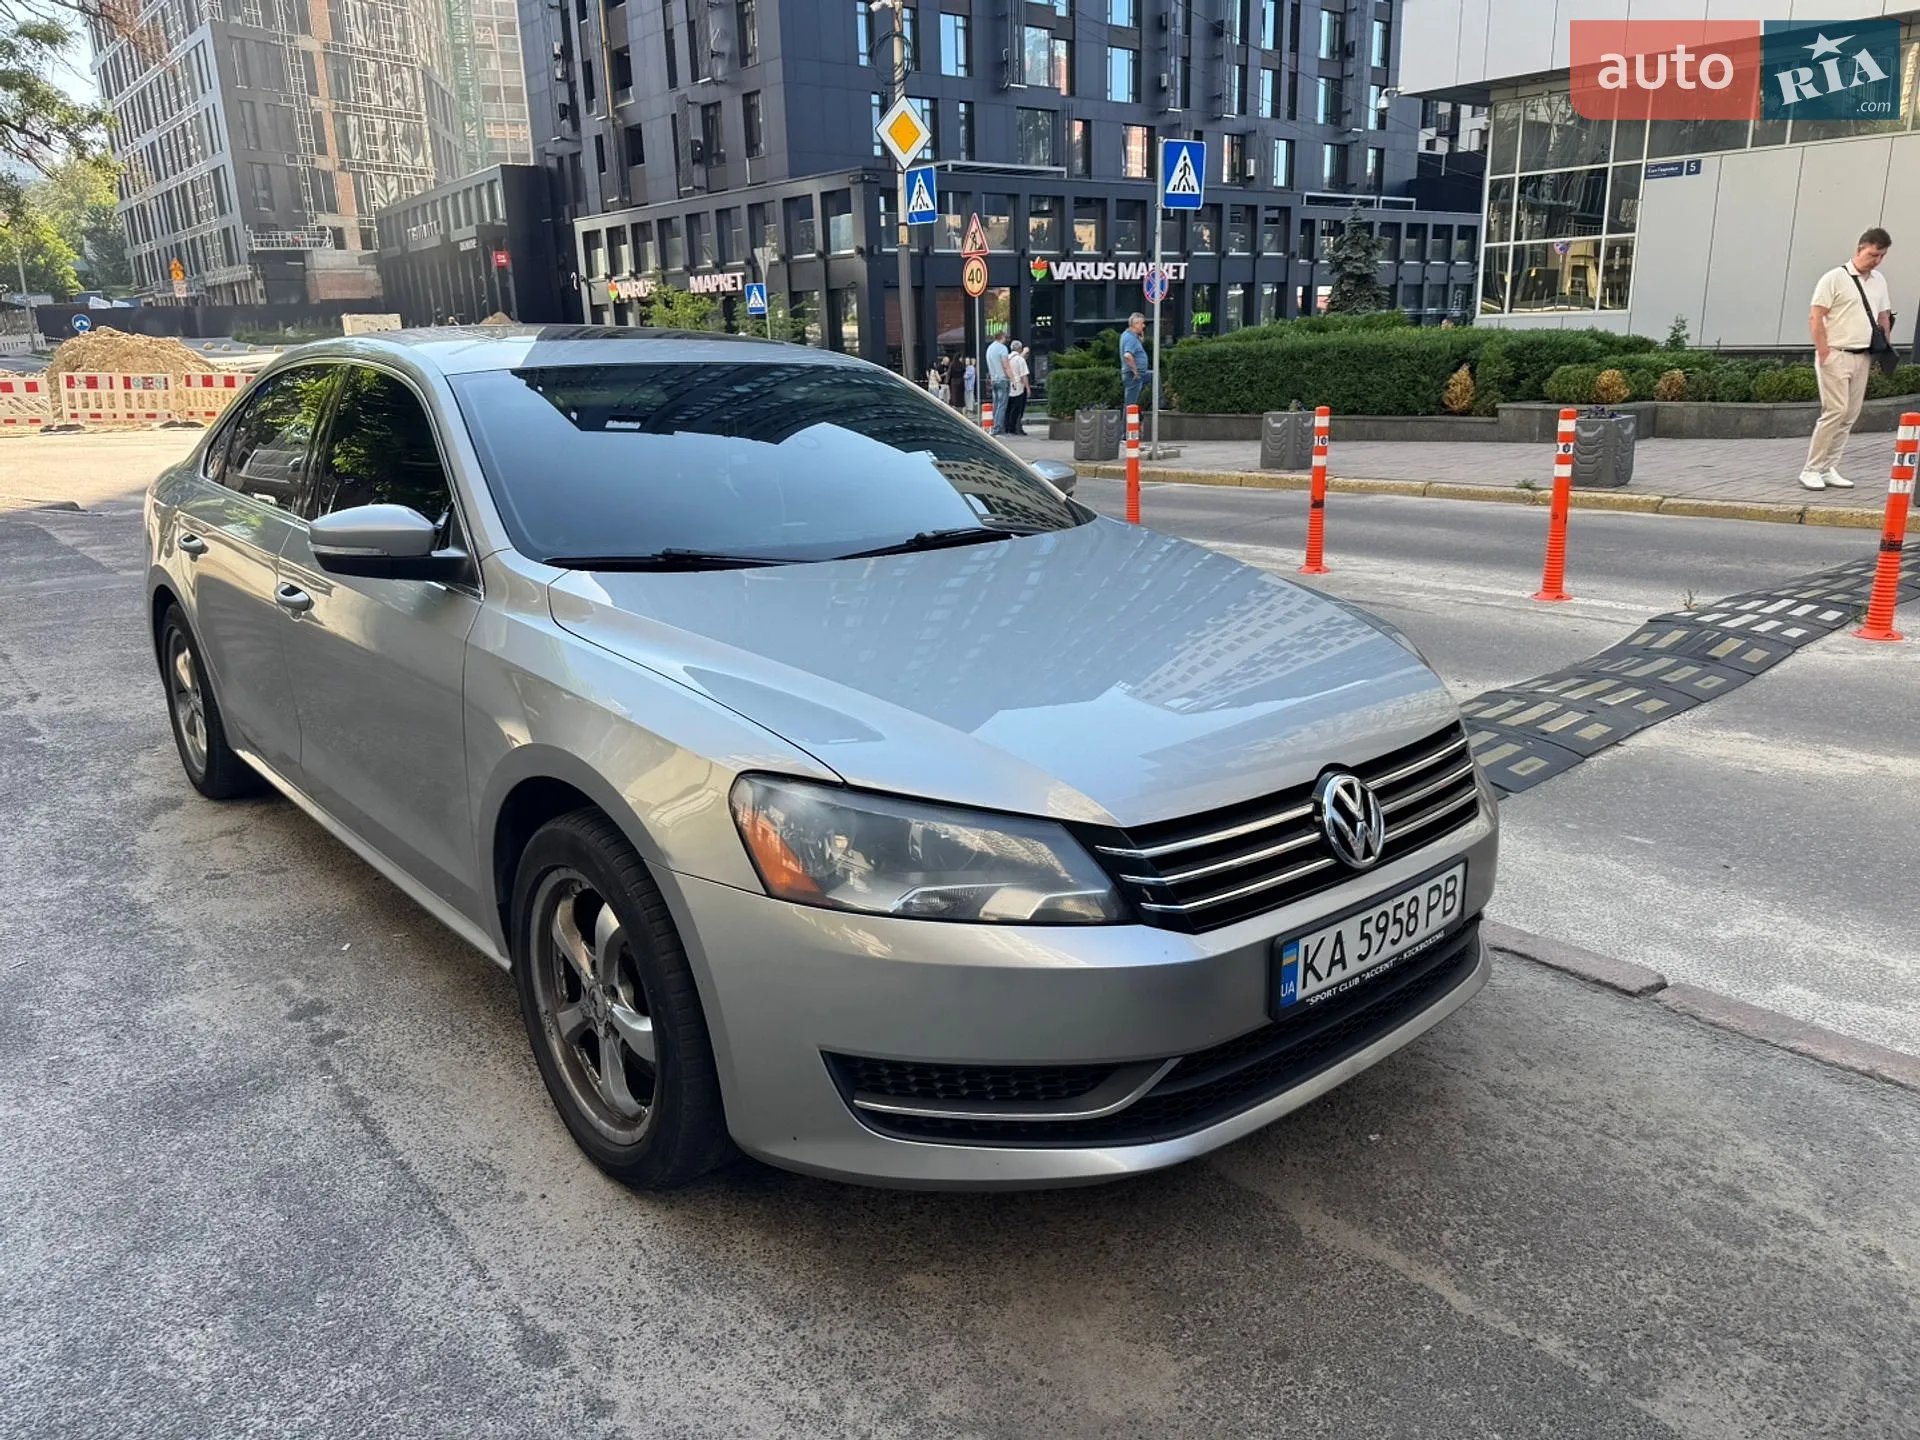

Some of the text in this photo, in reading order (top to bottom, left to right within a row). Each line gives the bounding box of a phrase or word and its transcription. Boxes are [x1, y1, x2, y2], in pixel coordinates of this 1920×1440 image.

[1689, 161, 1697, 172] 5
[967, 267, 983, 285] 40
[1050, 262, 1115, 280] VARUS
[1302, 874, 1458, 990] KA 5958 PB
[1281, 980, 1295, 997] UA
[1339, 976, 1360, 993] CLUB
